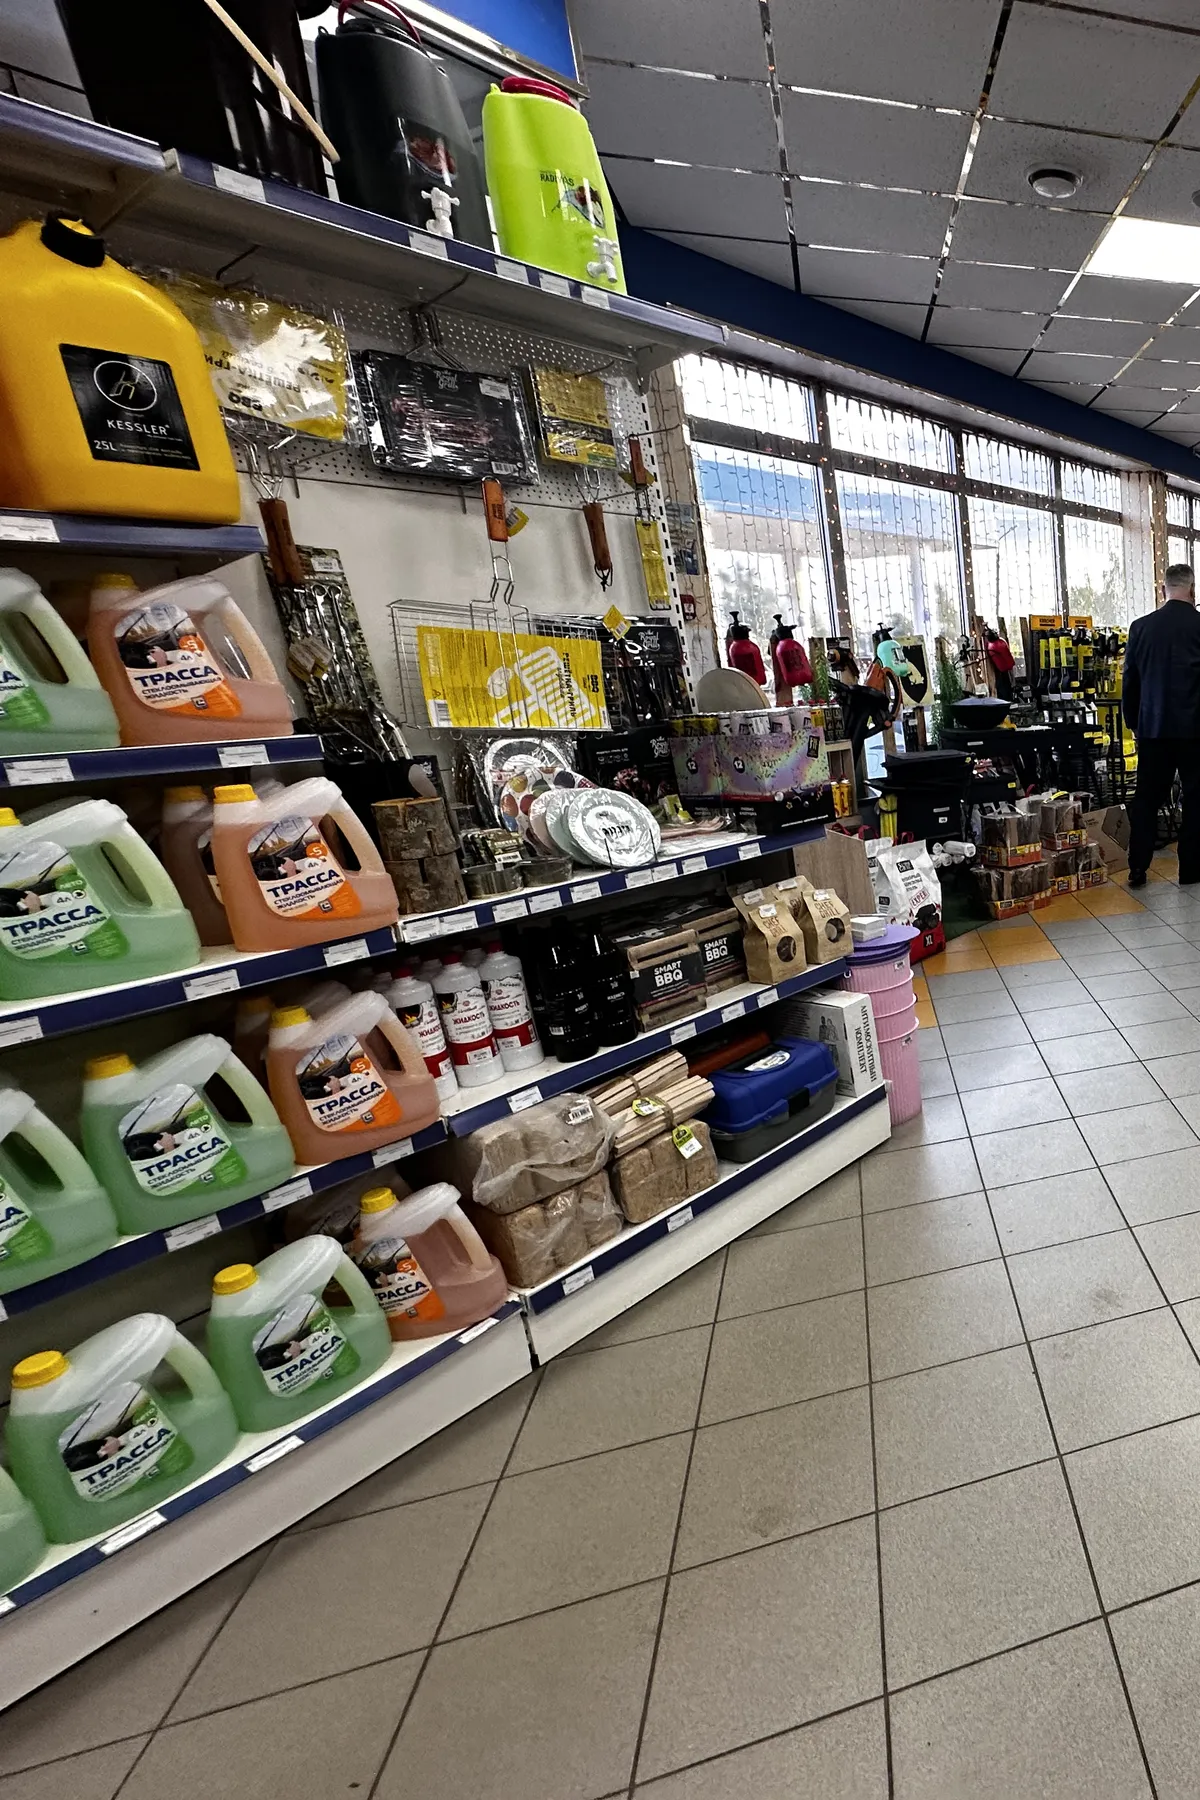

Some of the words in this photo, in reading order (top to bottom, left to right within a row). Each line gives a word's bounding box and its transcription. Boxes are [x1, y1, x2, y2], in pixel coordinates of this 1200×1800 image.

[106, 419, 168, 436] KESSLER
[94, 440, 118, 452] 25L
[133, 665, 219, 688] ТРАССА
[266, 868, 341, 898] ТРАССА
[1, 904, 104, 938] ТРАССА
[704, 937, 729, 952] SMART
[705, 944, 729, 962] BBQ
[653, 960, 683, 976] SMART
[654, 969, 684, 987] BBQ
[854, 1026, 868, 1074] КОМПЛЕКТ
[313, 1081, 382, 1115] ТРАССА
[140, 1136, 226, 1177] ТРАССА
[375, 1280, 427, 1302] РАССА
[270, 1335, 343, 1382] ТРАССА
[79, 1427, 172, 1485] ТРАССА
